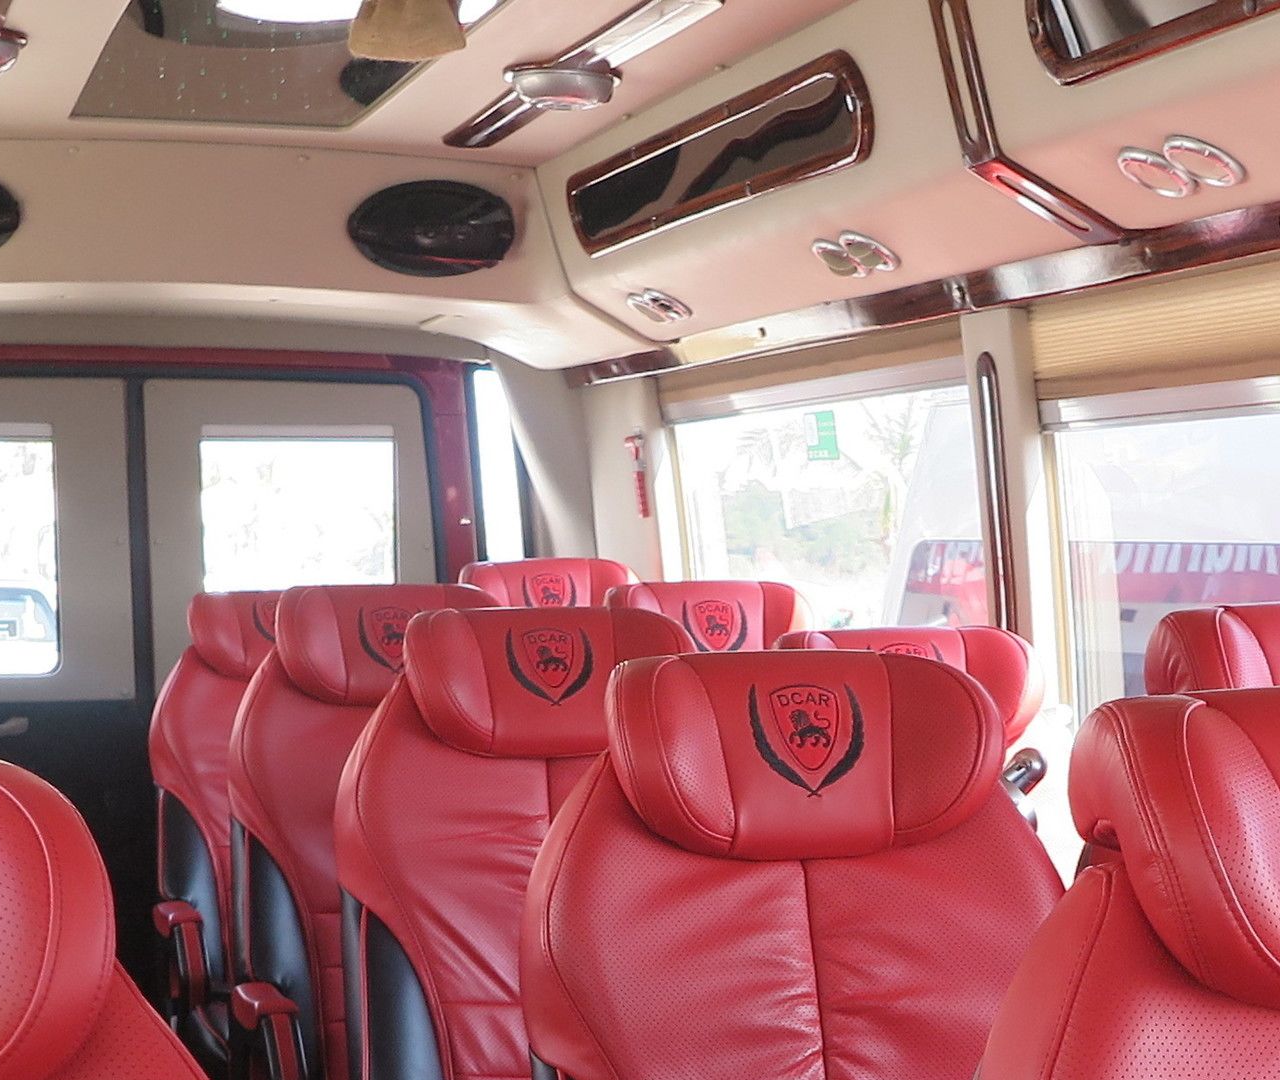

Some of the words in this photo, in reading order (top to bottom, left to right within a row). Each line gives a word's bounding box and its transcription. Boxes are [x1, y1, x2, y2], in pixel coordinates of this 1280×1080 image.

[698, 604, 729, 614] DCAR
[526, 632, 568, 645] DCAR
[777, 691, 831, 708] DCAR
